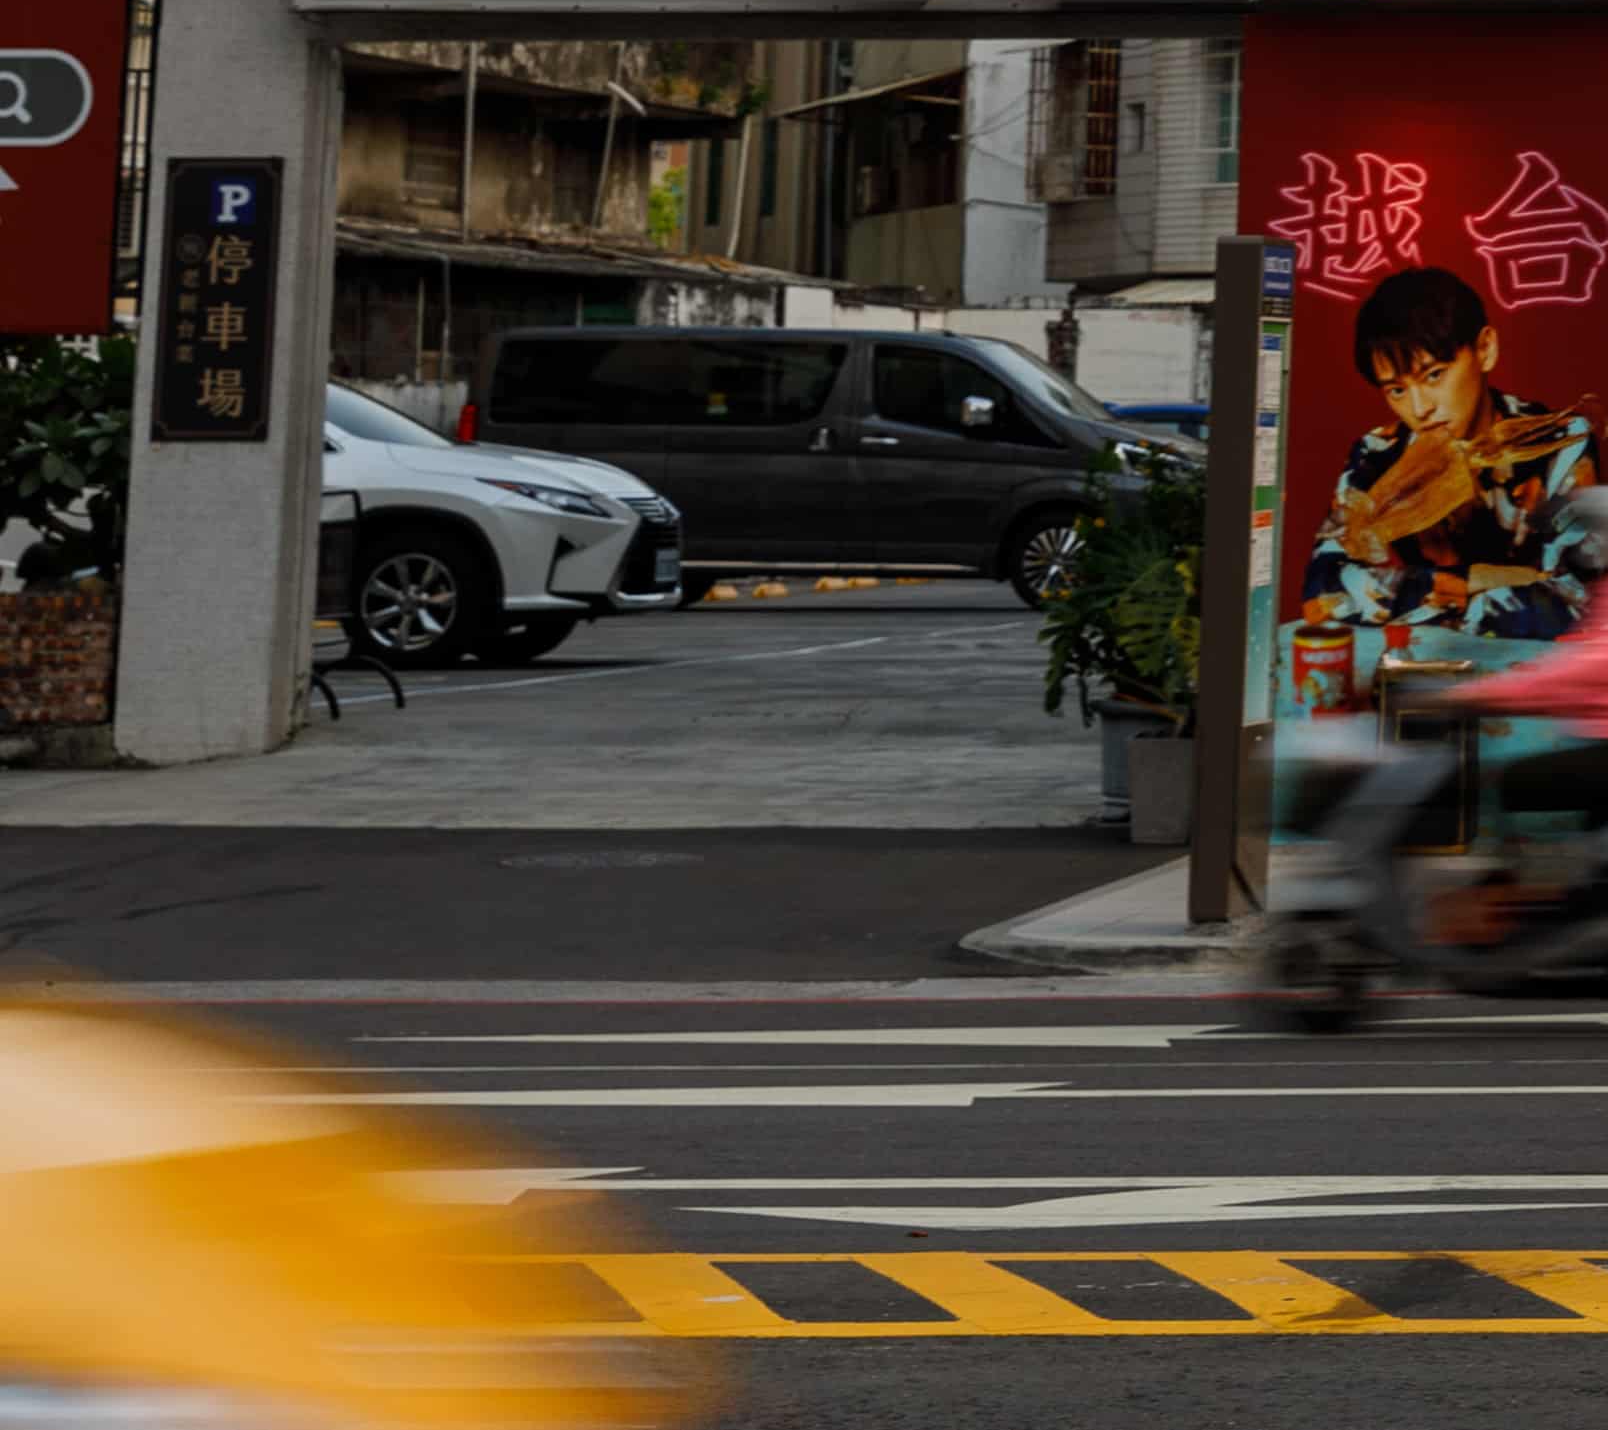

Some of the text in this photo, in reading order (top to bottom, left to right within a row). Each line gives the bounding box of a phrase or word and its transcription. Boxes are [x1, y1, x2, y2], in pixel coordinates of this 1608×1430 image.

[217, 183, 252, 224] P
[196, 233, 255, 421] 停車場
